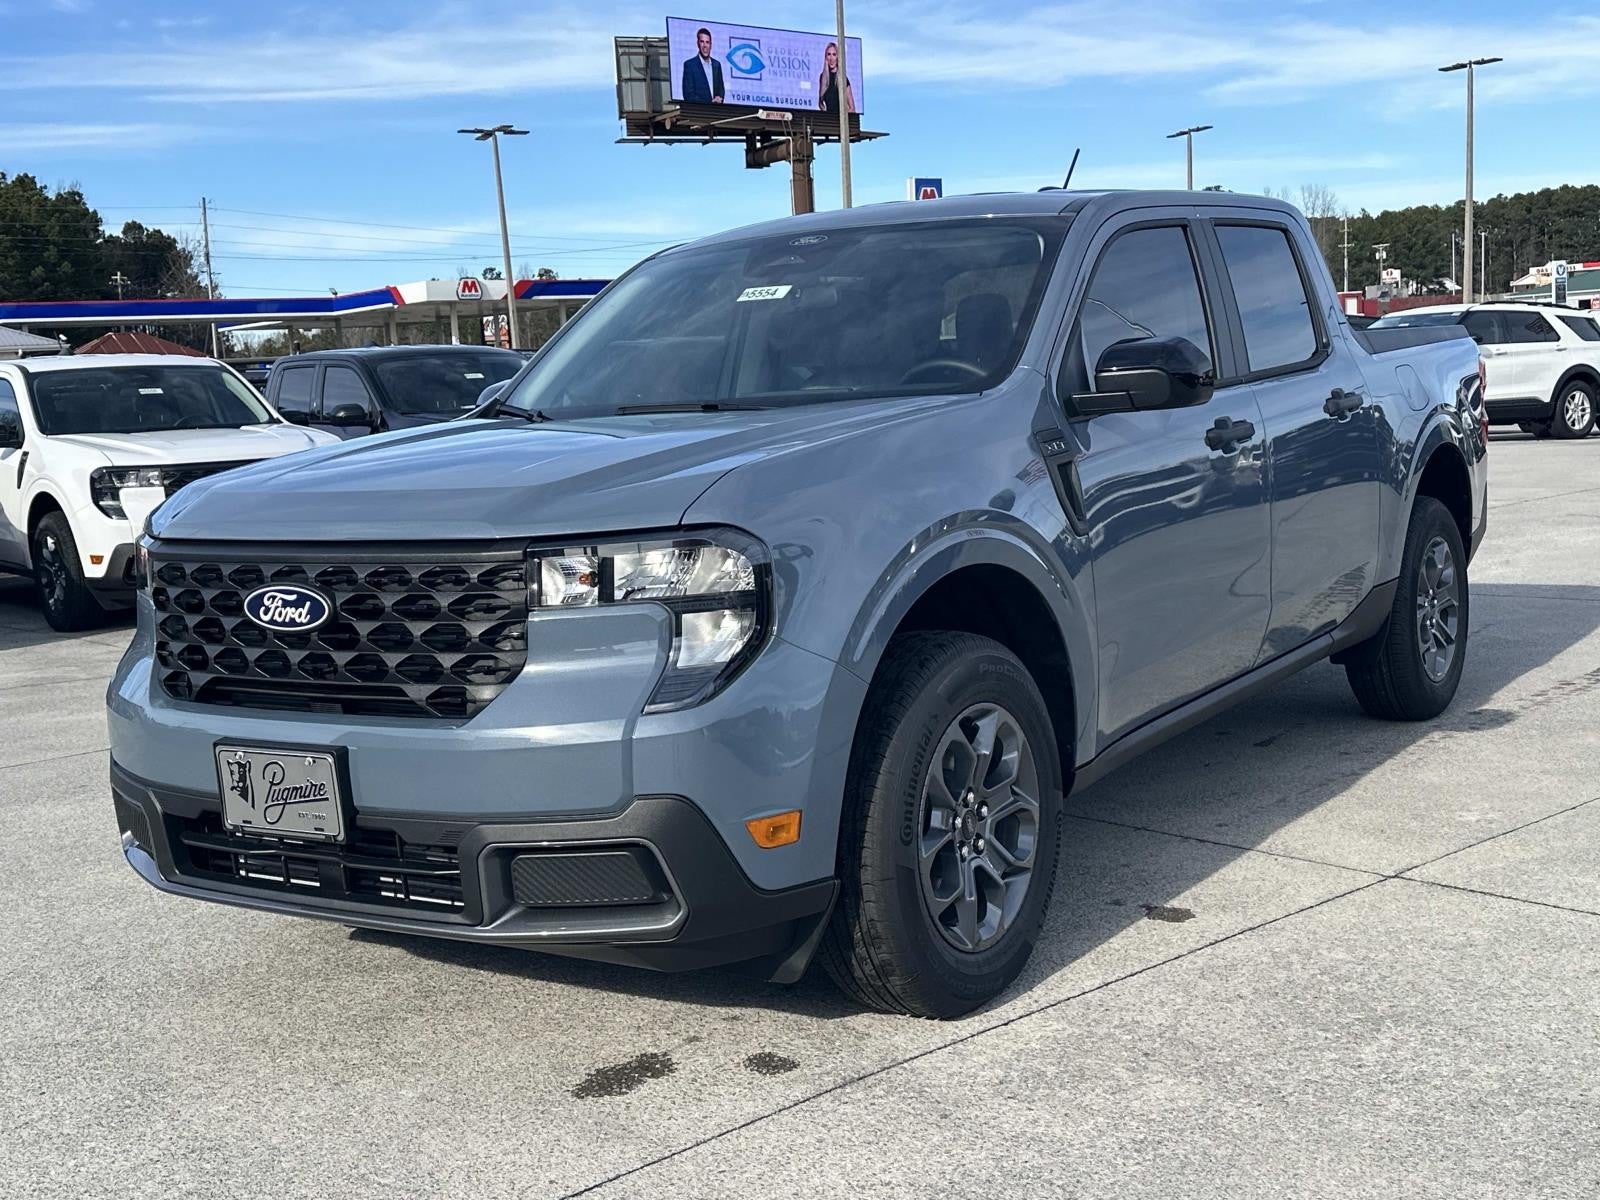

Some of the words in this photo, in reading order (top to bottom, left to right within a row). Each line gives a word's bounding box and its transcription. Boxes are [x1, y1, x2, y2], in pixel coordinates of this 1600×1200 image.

[767, 47, 810, 57] GEORGIA
[768, 55, 810, 71] VISION
[768, 69, 810, 79] INSTITUTE
[732, 94, 751, 102] YOUR
[752, 95, 774, 104] LOCAL
[775, 96, 812, 106] SURGEONS
[462, 280, 479, 293] M
[259, 591, 311, 624] Ford
[262, 760, 330, 825] Pugmire
